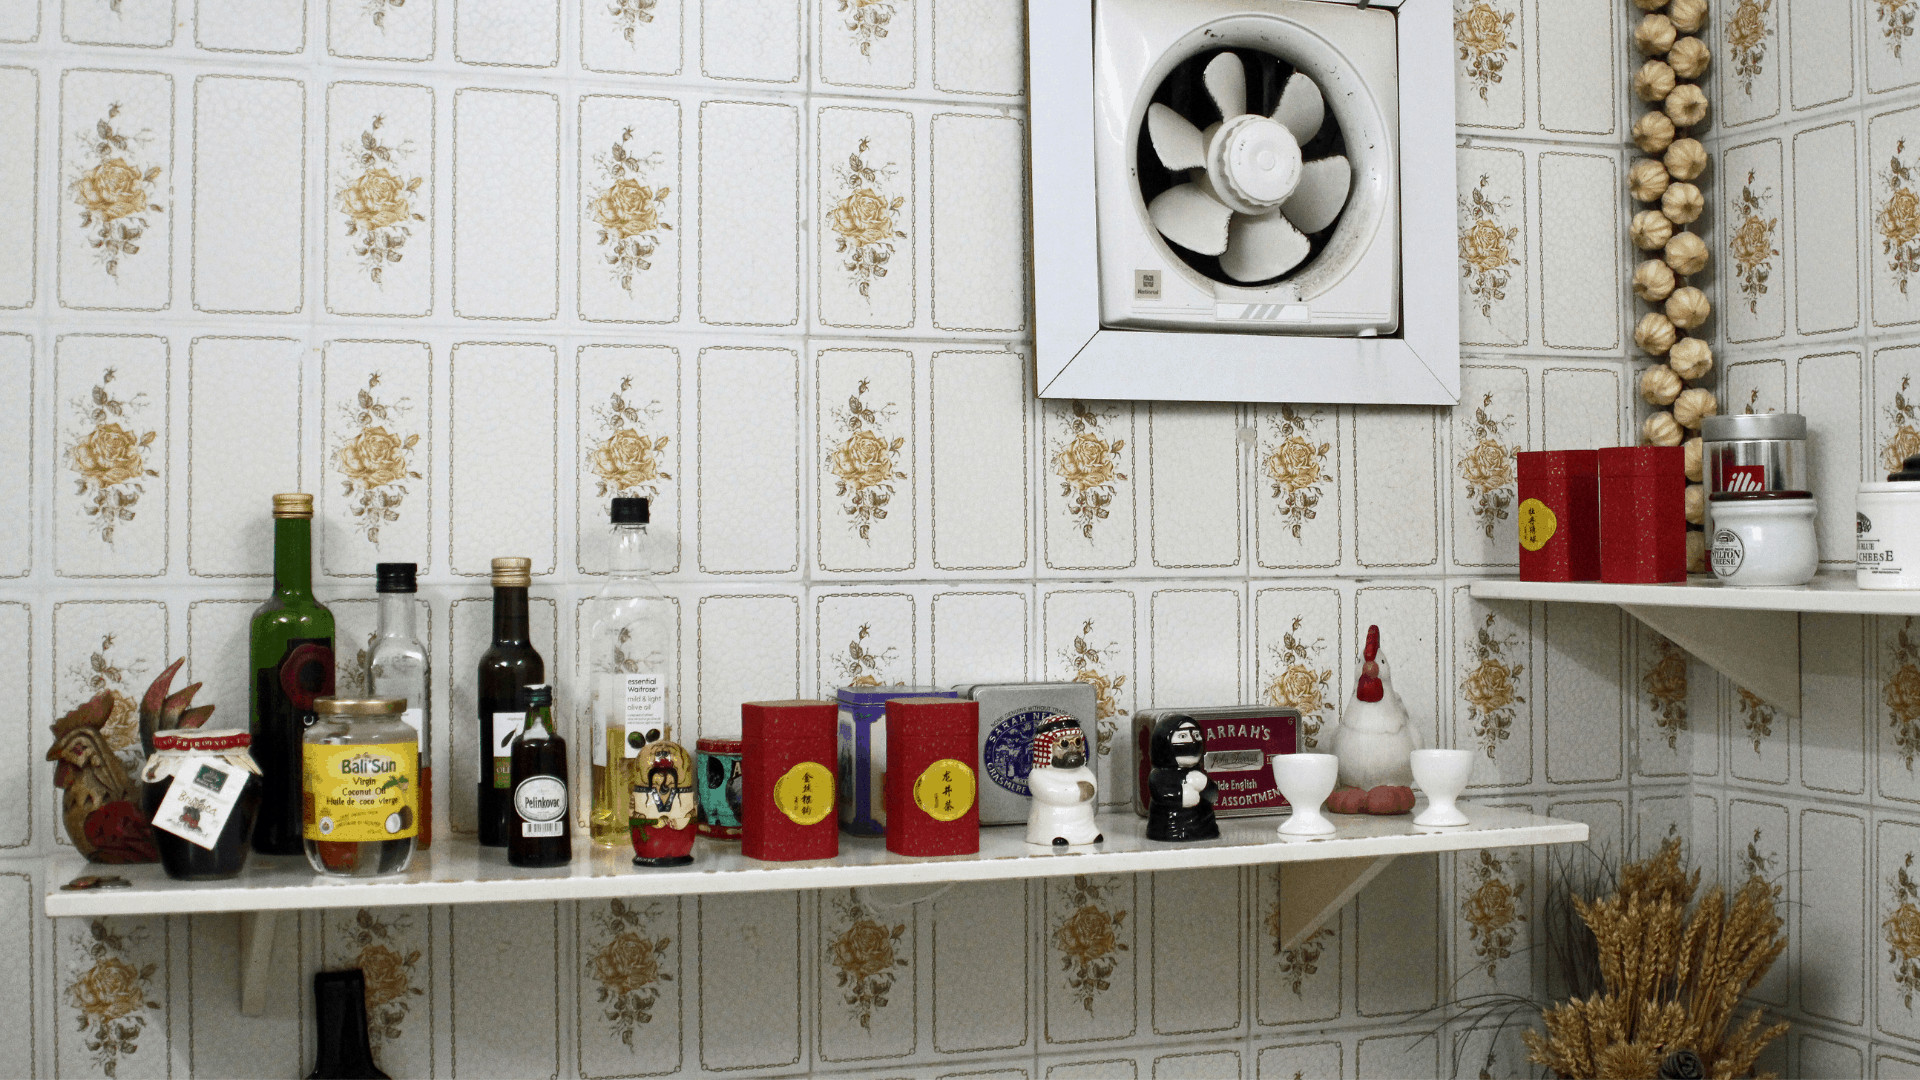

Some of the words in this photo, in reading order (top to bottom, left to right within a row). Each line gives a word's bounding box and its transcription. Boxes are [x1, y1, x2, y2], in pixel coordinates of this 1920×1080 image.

[1206, 724, 1272, 742] ARRAH'S
[353, 777, 376, 787] Virgin
[1230, 779, 1258, 792] English
[342, 787, 372, 797] Coconut
[1221, 788, 1282, 807] ASSORTMEN
[346, 796, 355, 806] de
[524, 796, 560, 809] Pelinkovac
